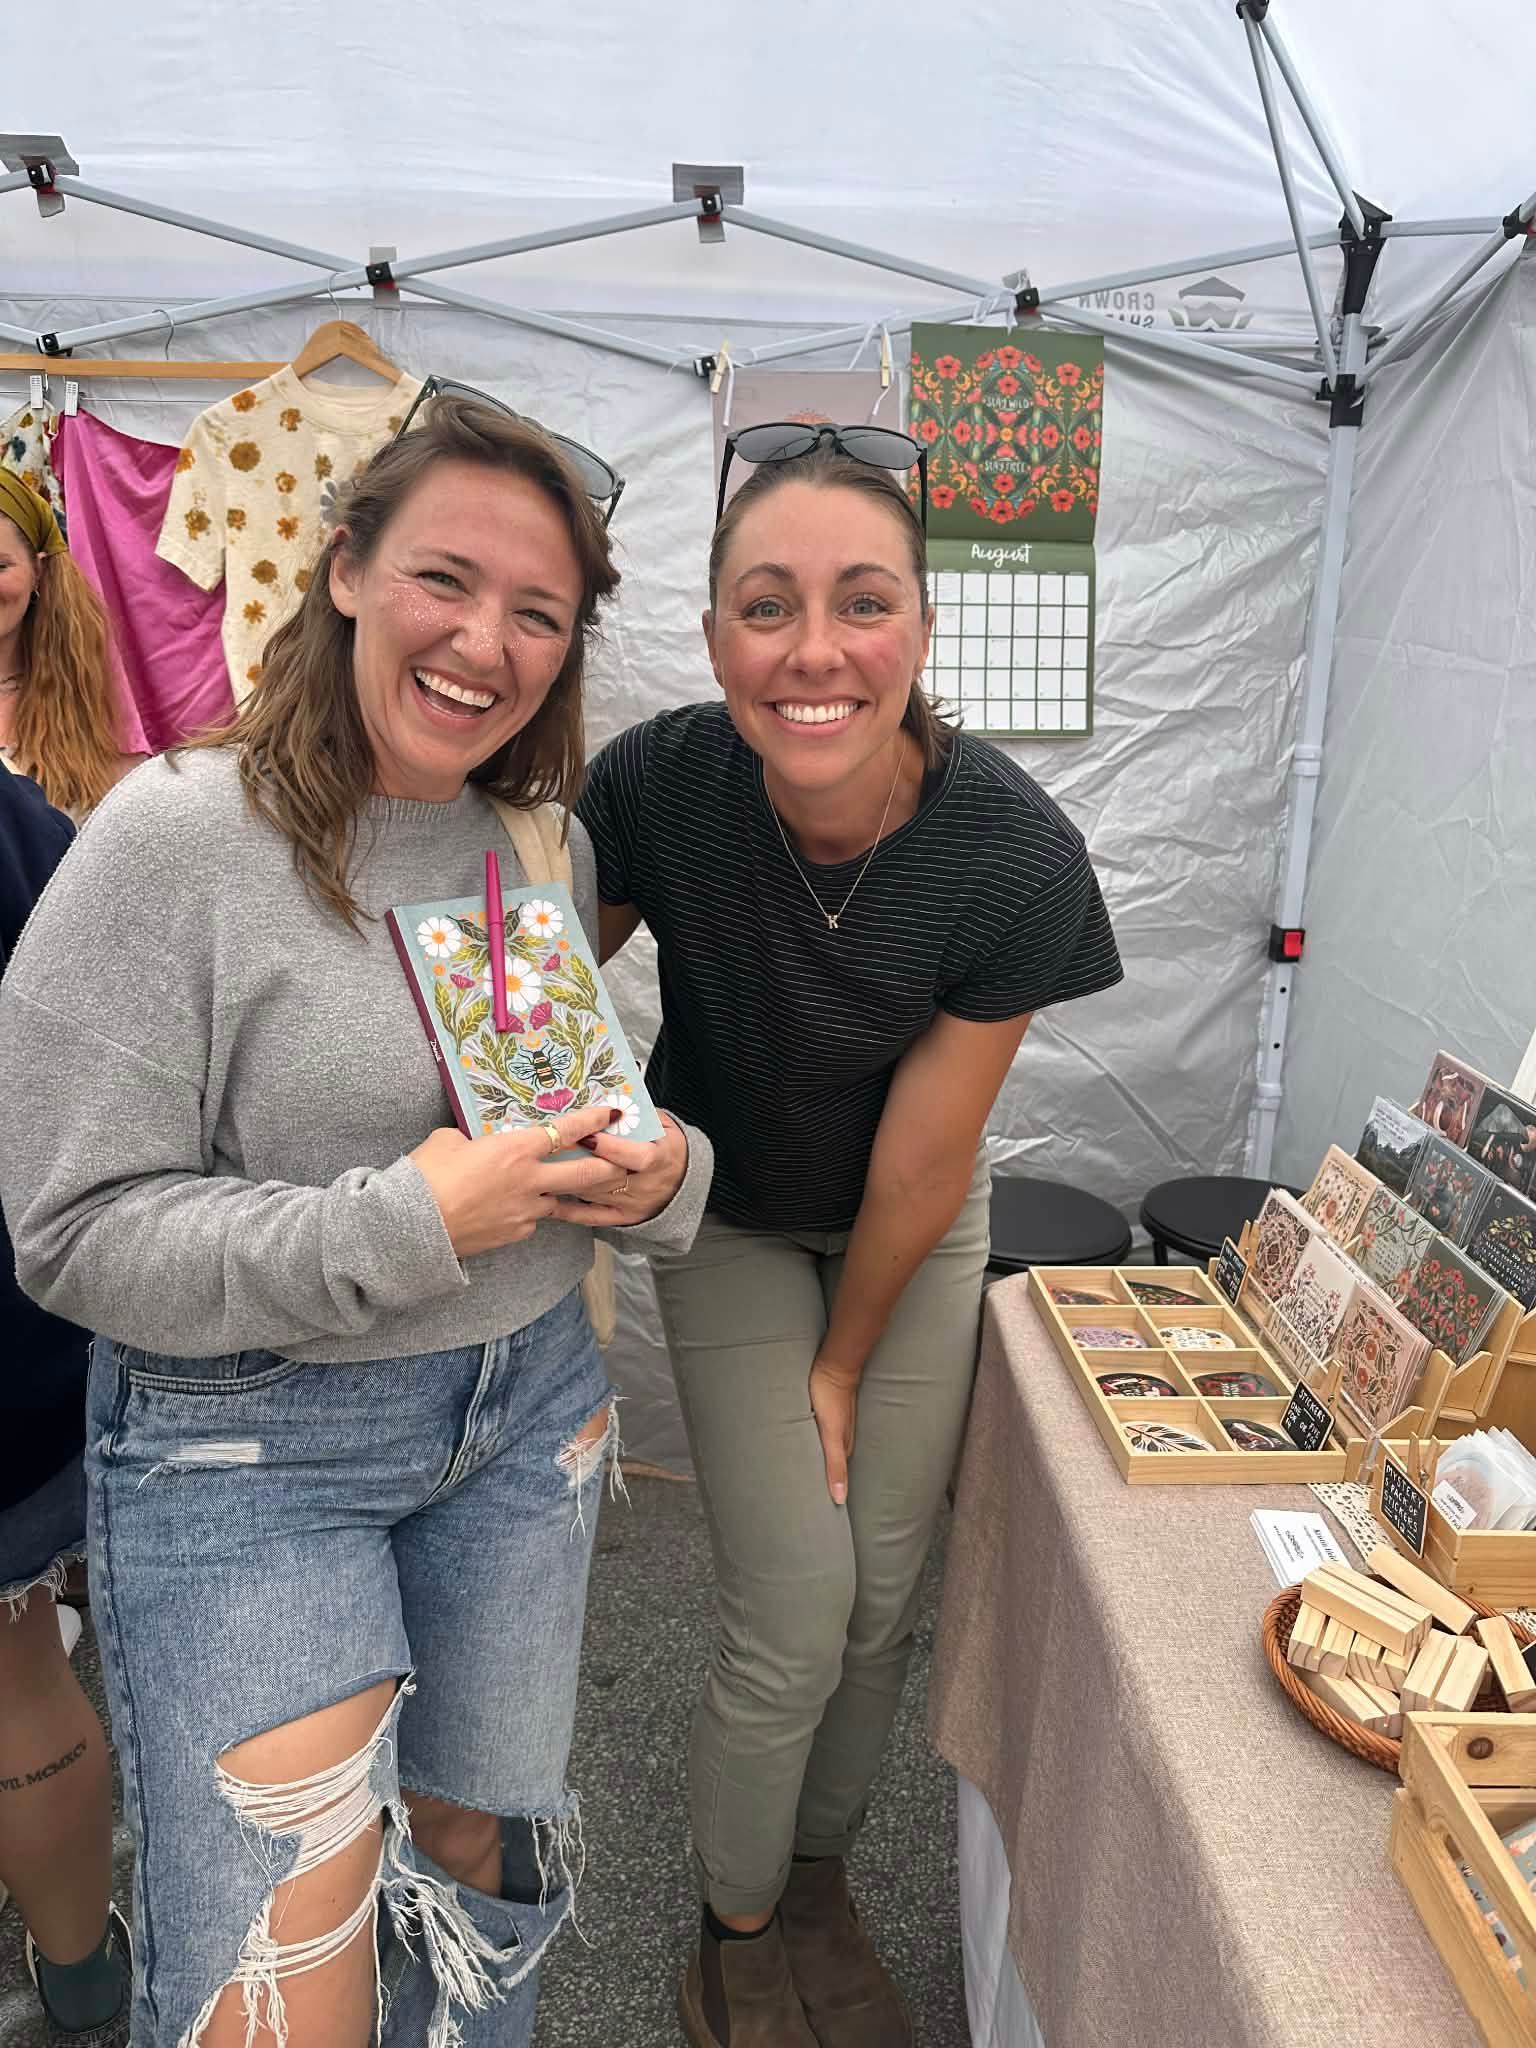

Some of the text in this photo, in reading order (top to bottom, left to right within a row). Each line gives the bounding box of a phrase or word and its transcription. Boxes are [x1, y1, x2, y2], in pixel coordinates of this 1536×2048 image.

[1009, 398, 1030, 409] WILD
[971, 543, 1033, 569] August
[1291, 1401, 1302, 1417] ONE
[1298, 1389, 1326, 1423] STICKERS
[1385, 1464, 1424, 1509] MYSTERY
[1390, 1483, 1408, 1507] PACK
[1408, 1505, 1418, 1517] OF
[1383, 1490, 1419, 1533] STICKERS
